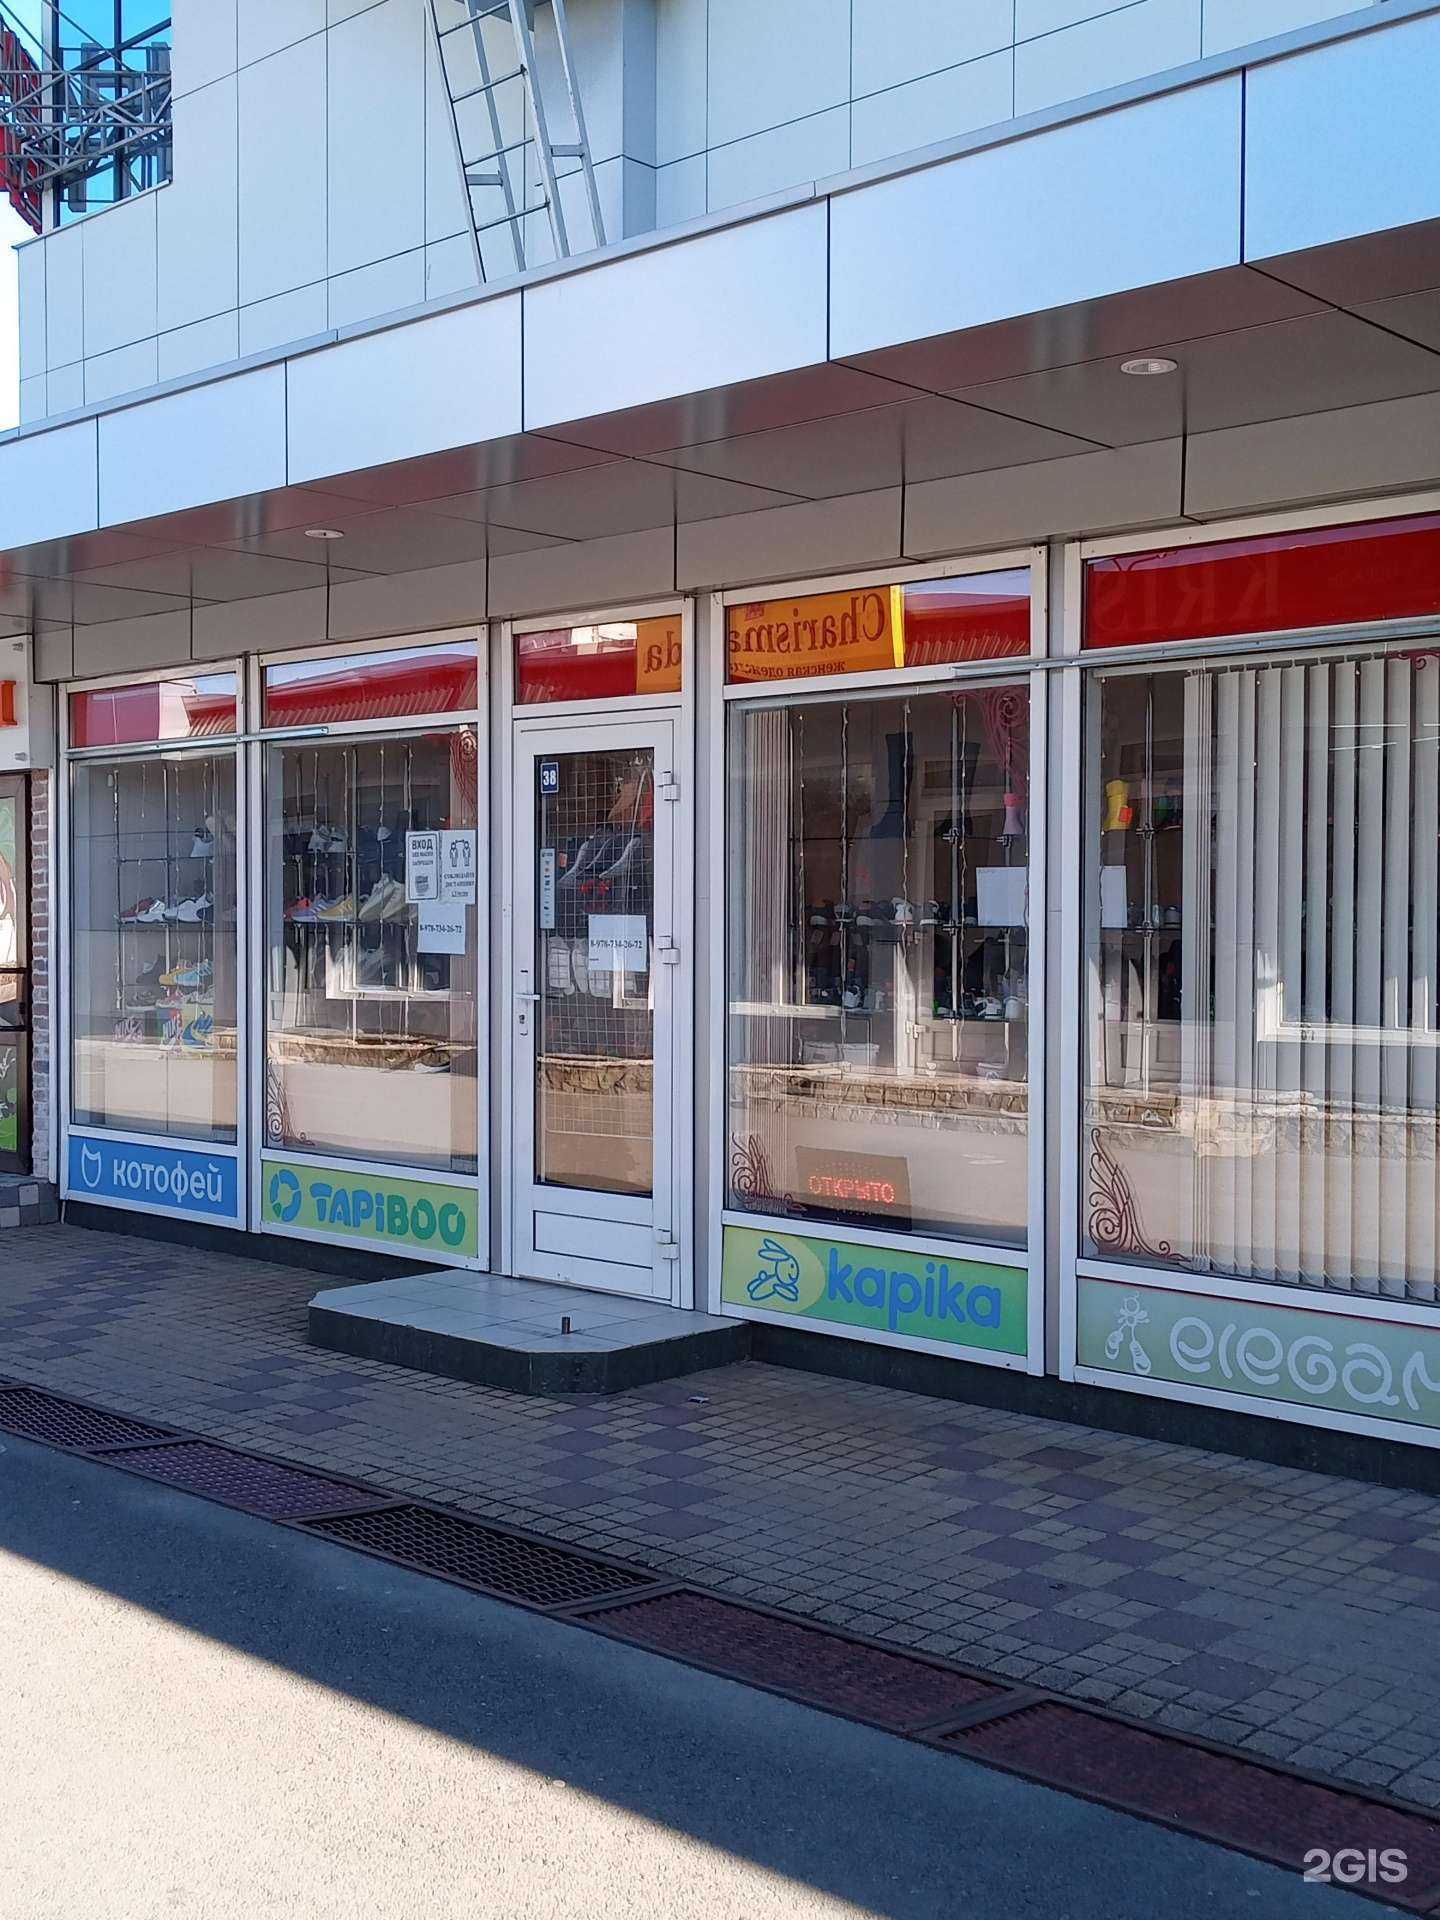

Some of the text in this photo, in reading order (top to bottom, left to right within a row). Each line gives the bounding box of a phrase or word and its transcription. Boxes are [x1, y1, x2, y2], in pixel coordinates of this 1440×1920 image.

[542, 769, 557, 786] 38
[411, 838, 433, 851] ВХОД
[807, 1175, 896, 1204] ОТКРЫТО
[827, 1247, 1003, 1330] kapika
